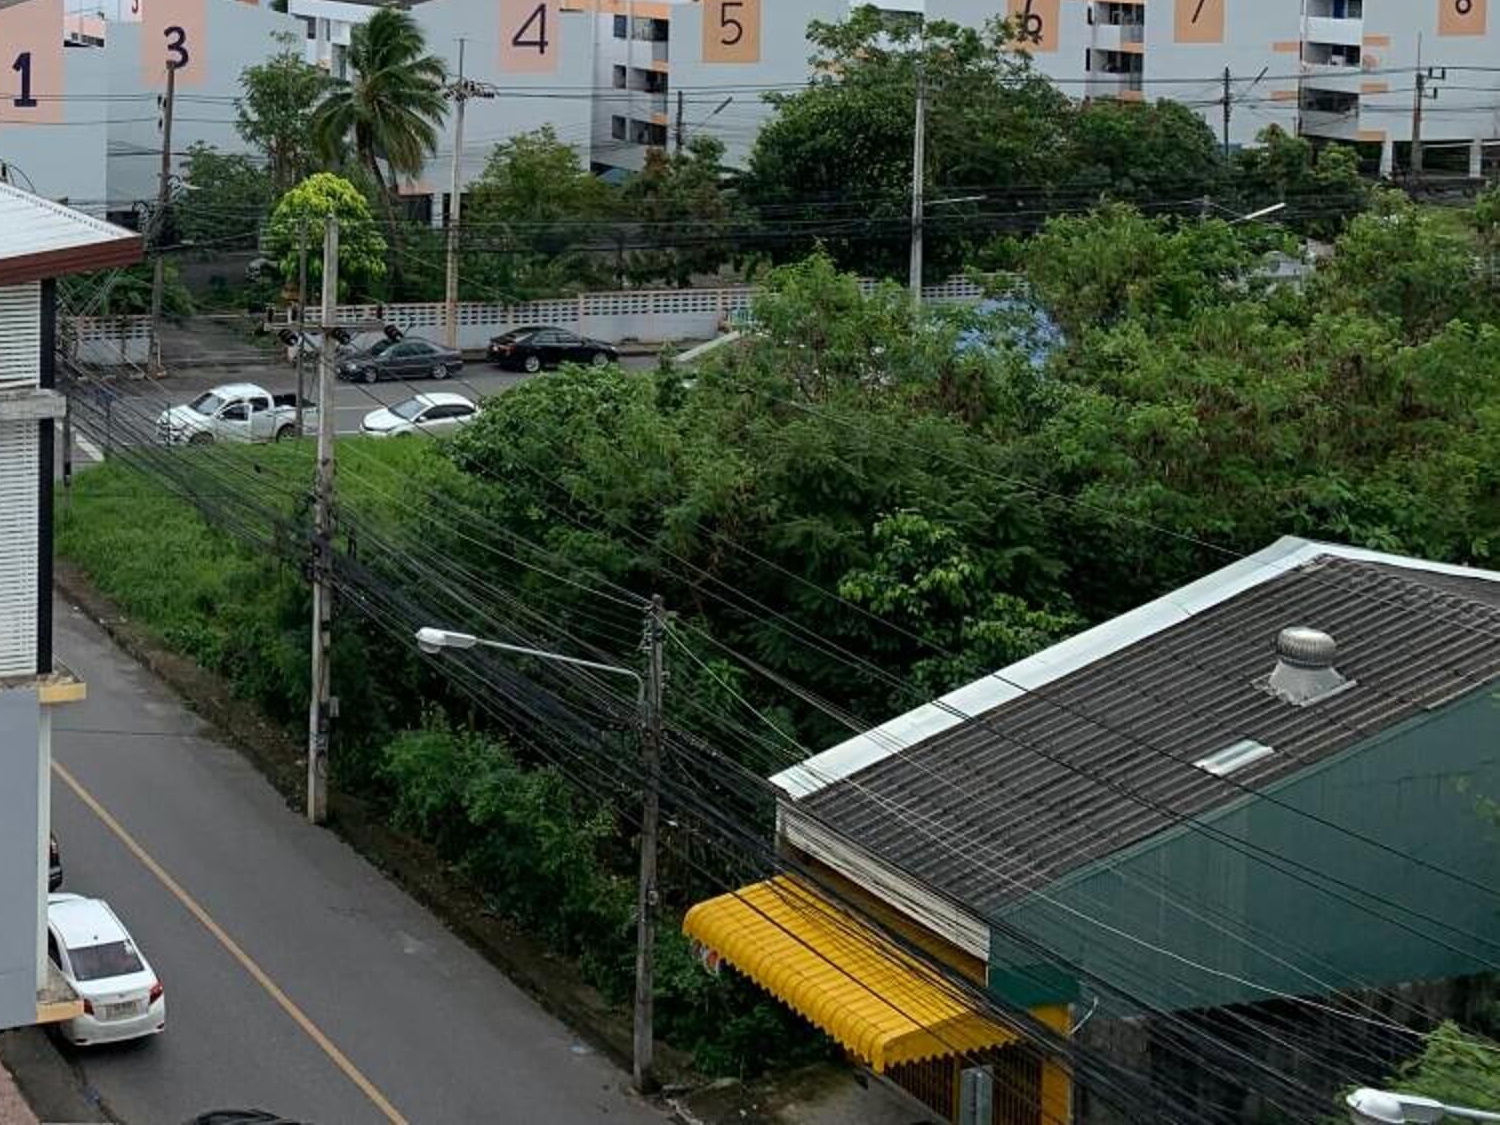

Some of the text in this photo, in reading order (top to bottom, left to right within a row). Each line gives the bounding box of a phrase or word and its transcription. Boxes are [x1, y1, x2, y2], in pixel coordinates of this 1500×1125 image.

[511, 3, 548, 55] 4
[720, 1, 744, 45] 5
[163, 26, 190, 69] 3
[11, 52, 38, 107] 1
